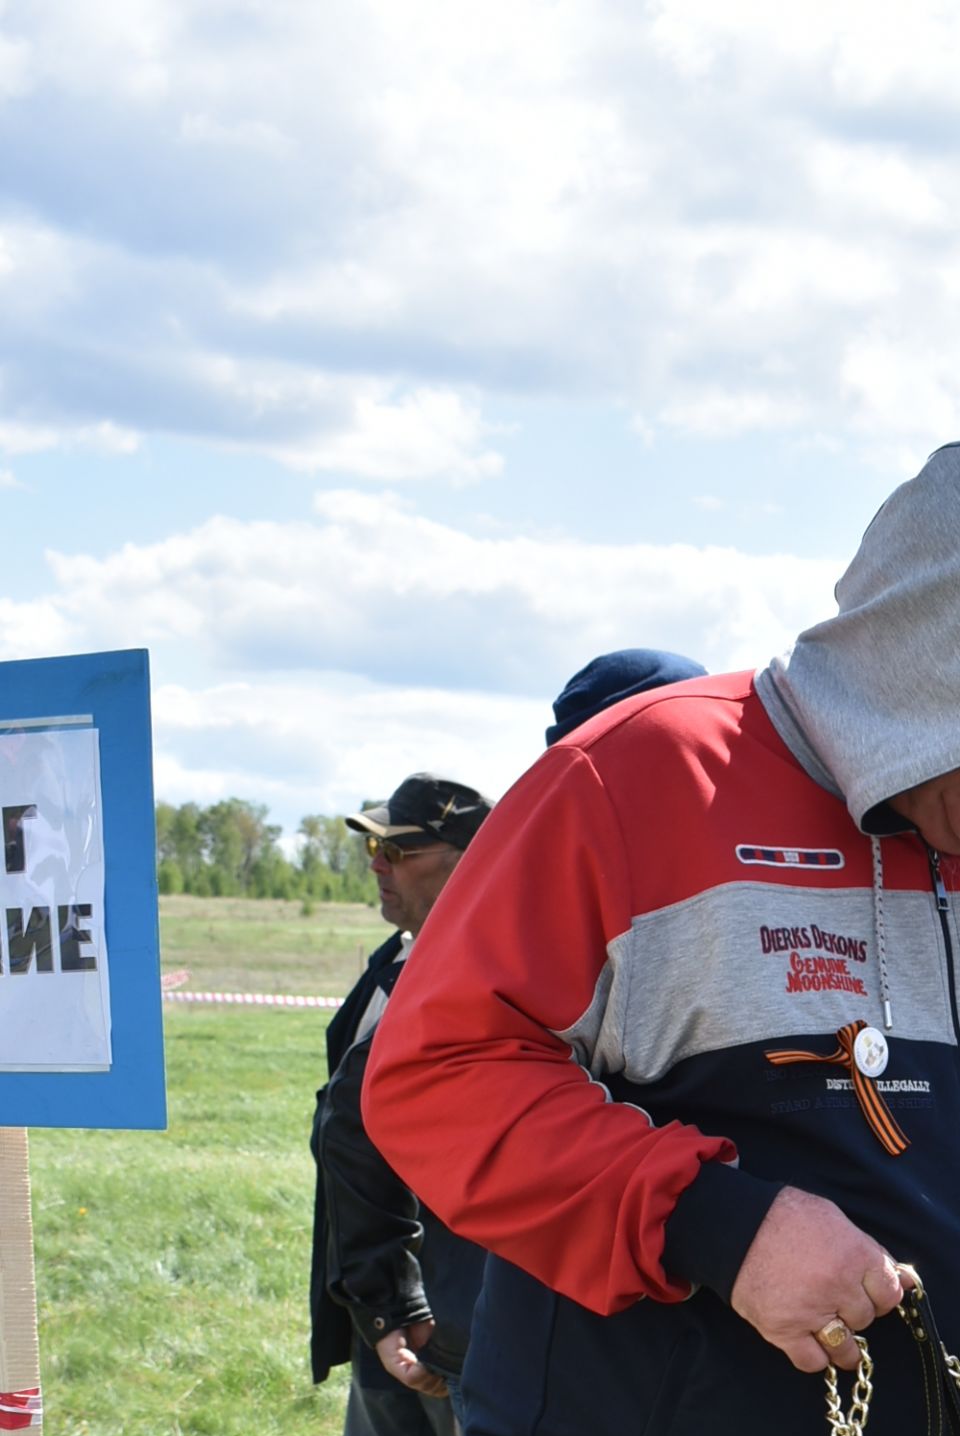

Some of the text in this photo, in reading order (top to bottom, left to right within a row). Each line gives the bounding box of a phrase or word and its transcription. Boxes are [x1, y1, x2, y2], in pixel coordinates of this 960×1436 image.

[0, 903, 98, 975] ИЕ
[760, 924, 868, 963] DIERKS DEKONS
